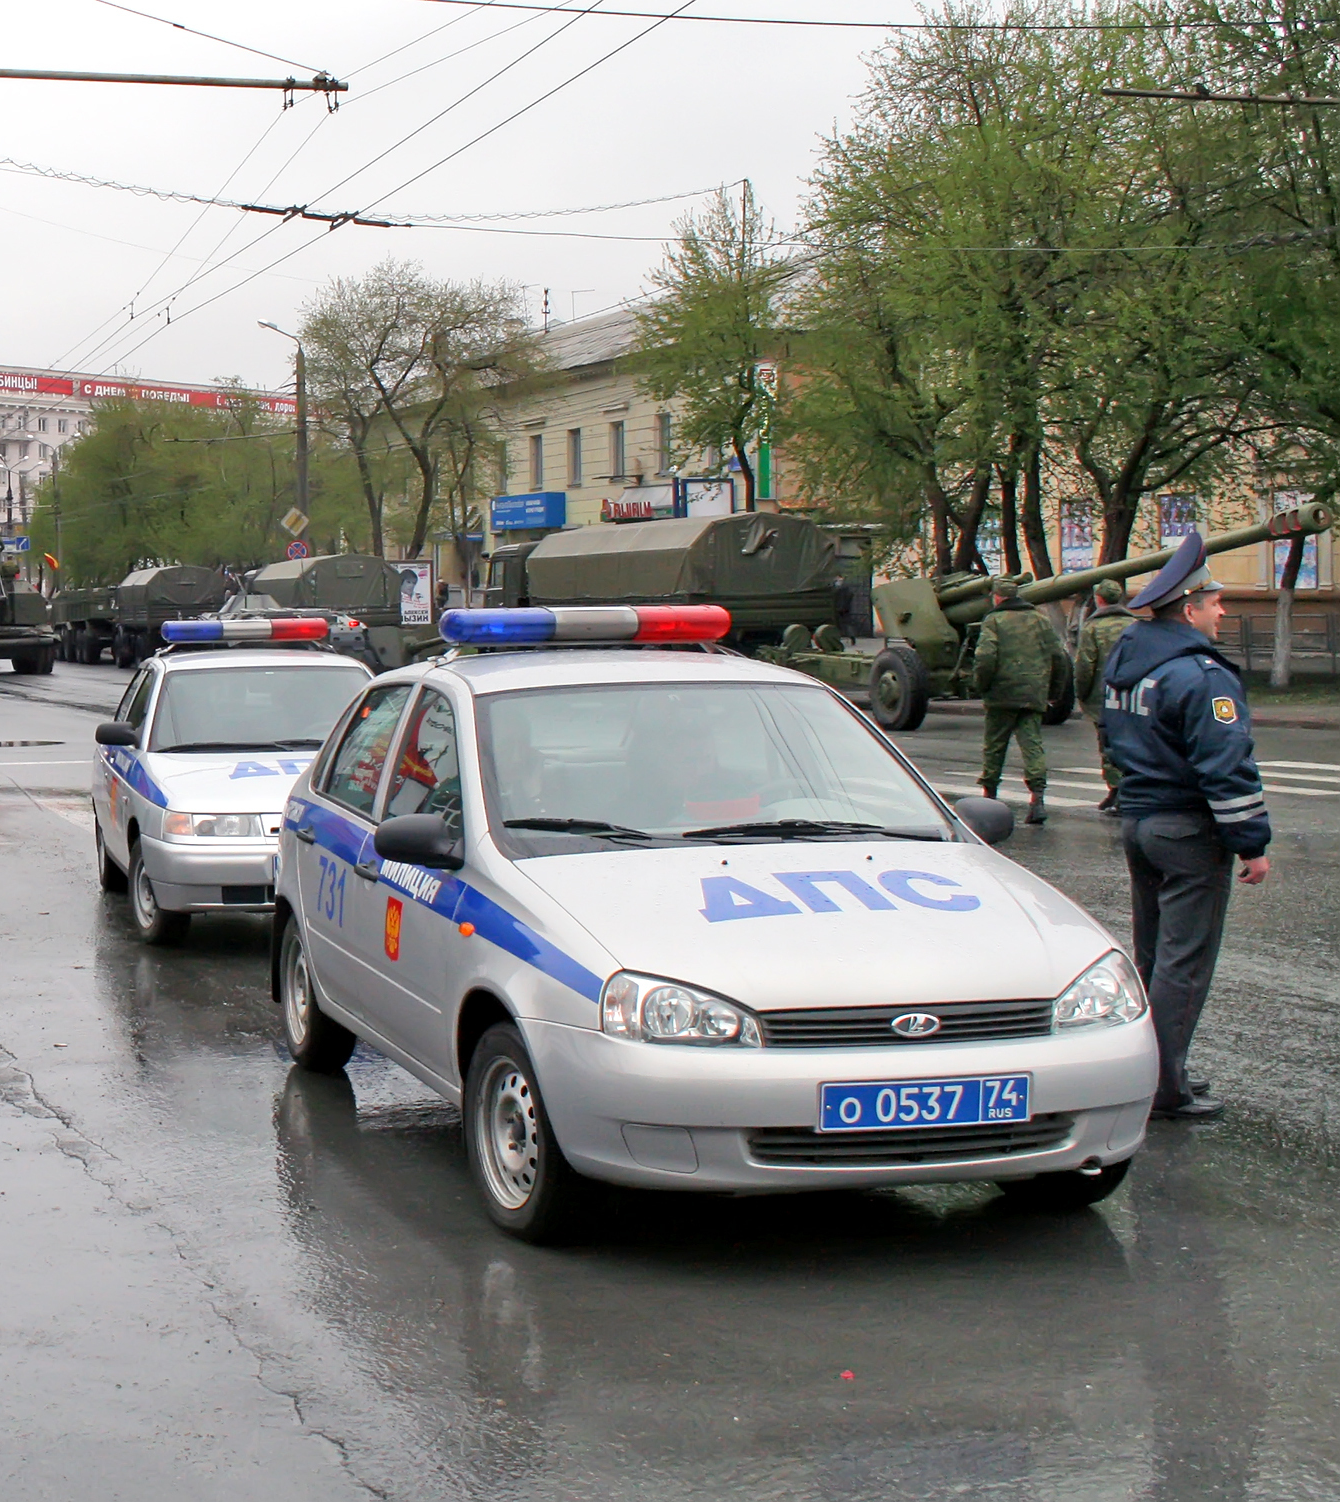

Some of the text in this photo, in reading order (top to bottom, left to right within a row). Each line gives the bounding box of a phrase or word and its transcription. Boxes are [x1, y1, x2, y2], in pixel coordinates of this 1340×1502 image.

[85, 385, 92, 394] С
[401, 615, 429, 623] ЫЗИН
[317, 855, 347, 928] 731
[380, 859, 442, 904] МИЛИЦИЯ
[698, 870, 981, 923] ДПС
[876, 1086, 964, 1124] 0537
[985, 1081, 1017, 1108] 74
[989, 1107, 1012, 1118] RUS
